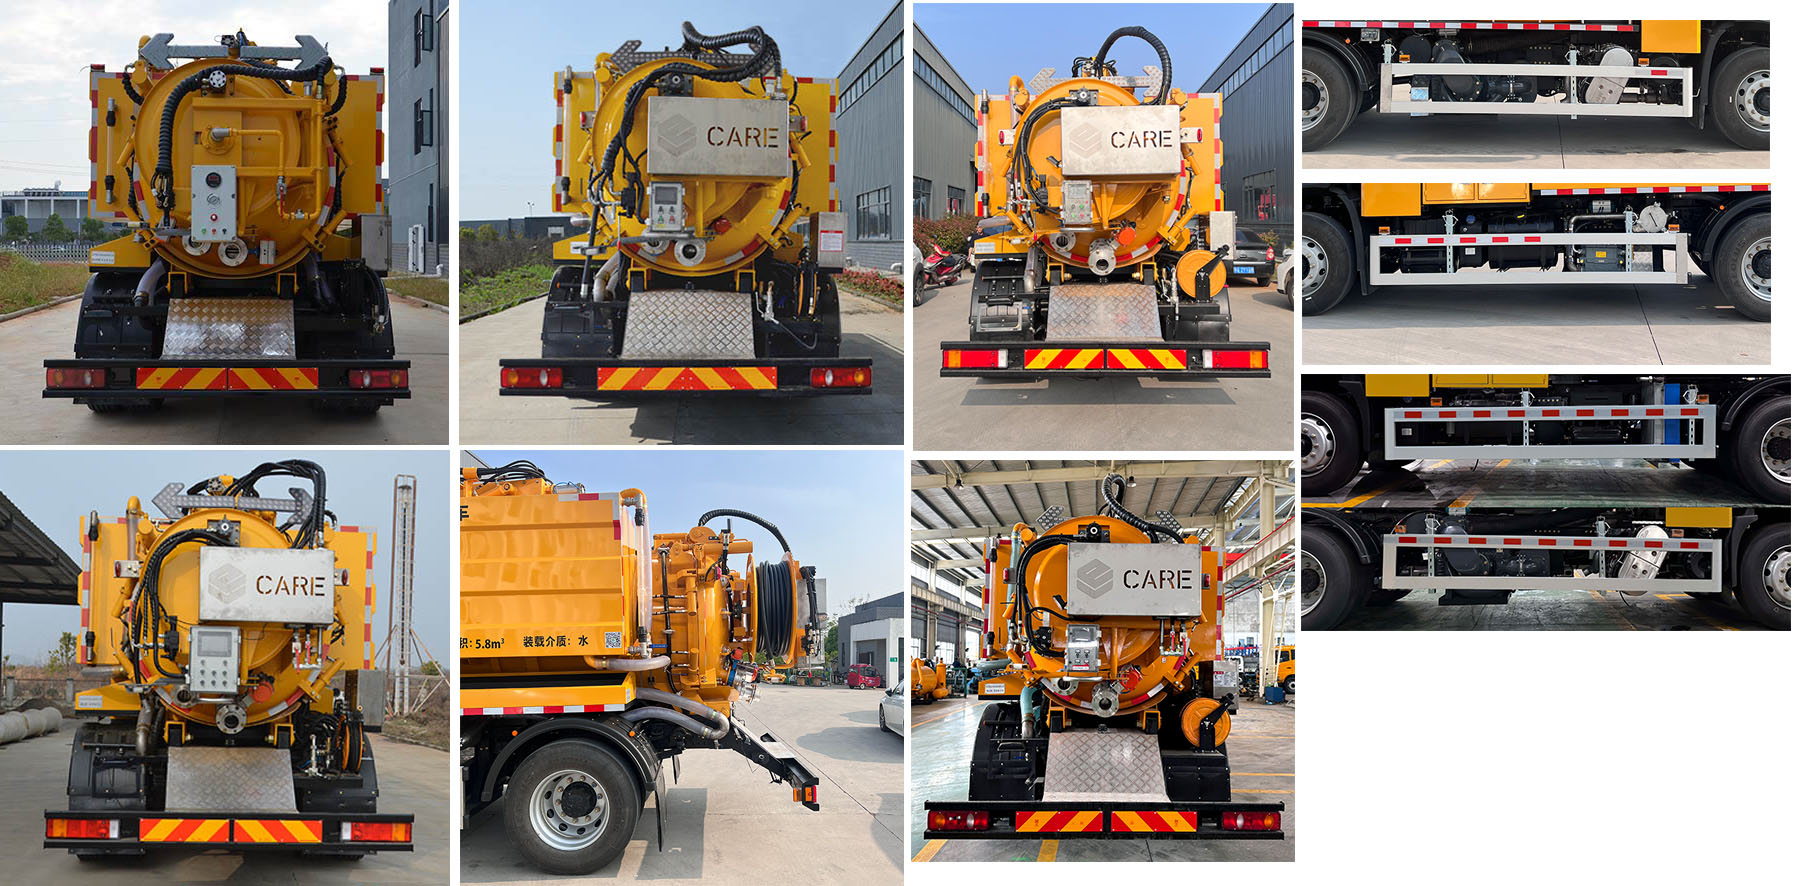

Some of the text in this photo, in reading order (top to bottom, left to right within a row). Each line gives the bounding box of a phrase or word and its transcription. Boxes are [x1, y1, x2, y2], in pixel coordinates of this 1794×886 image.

[708, 126, 779, 148] CARE
[1111, 130, 1173, 149] CARE
[256, 575, 326, 597] CARE
[1123, 569, 1192, 590] CARE
